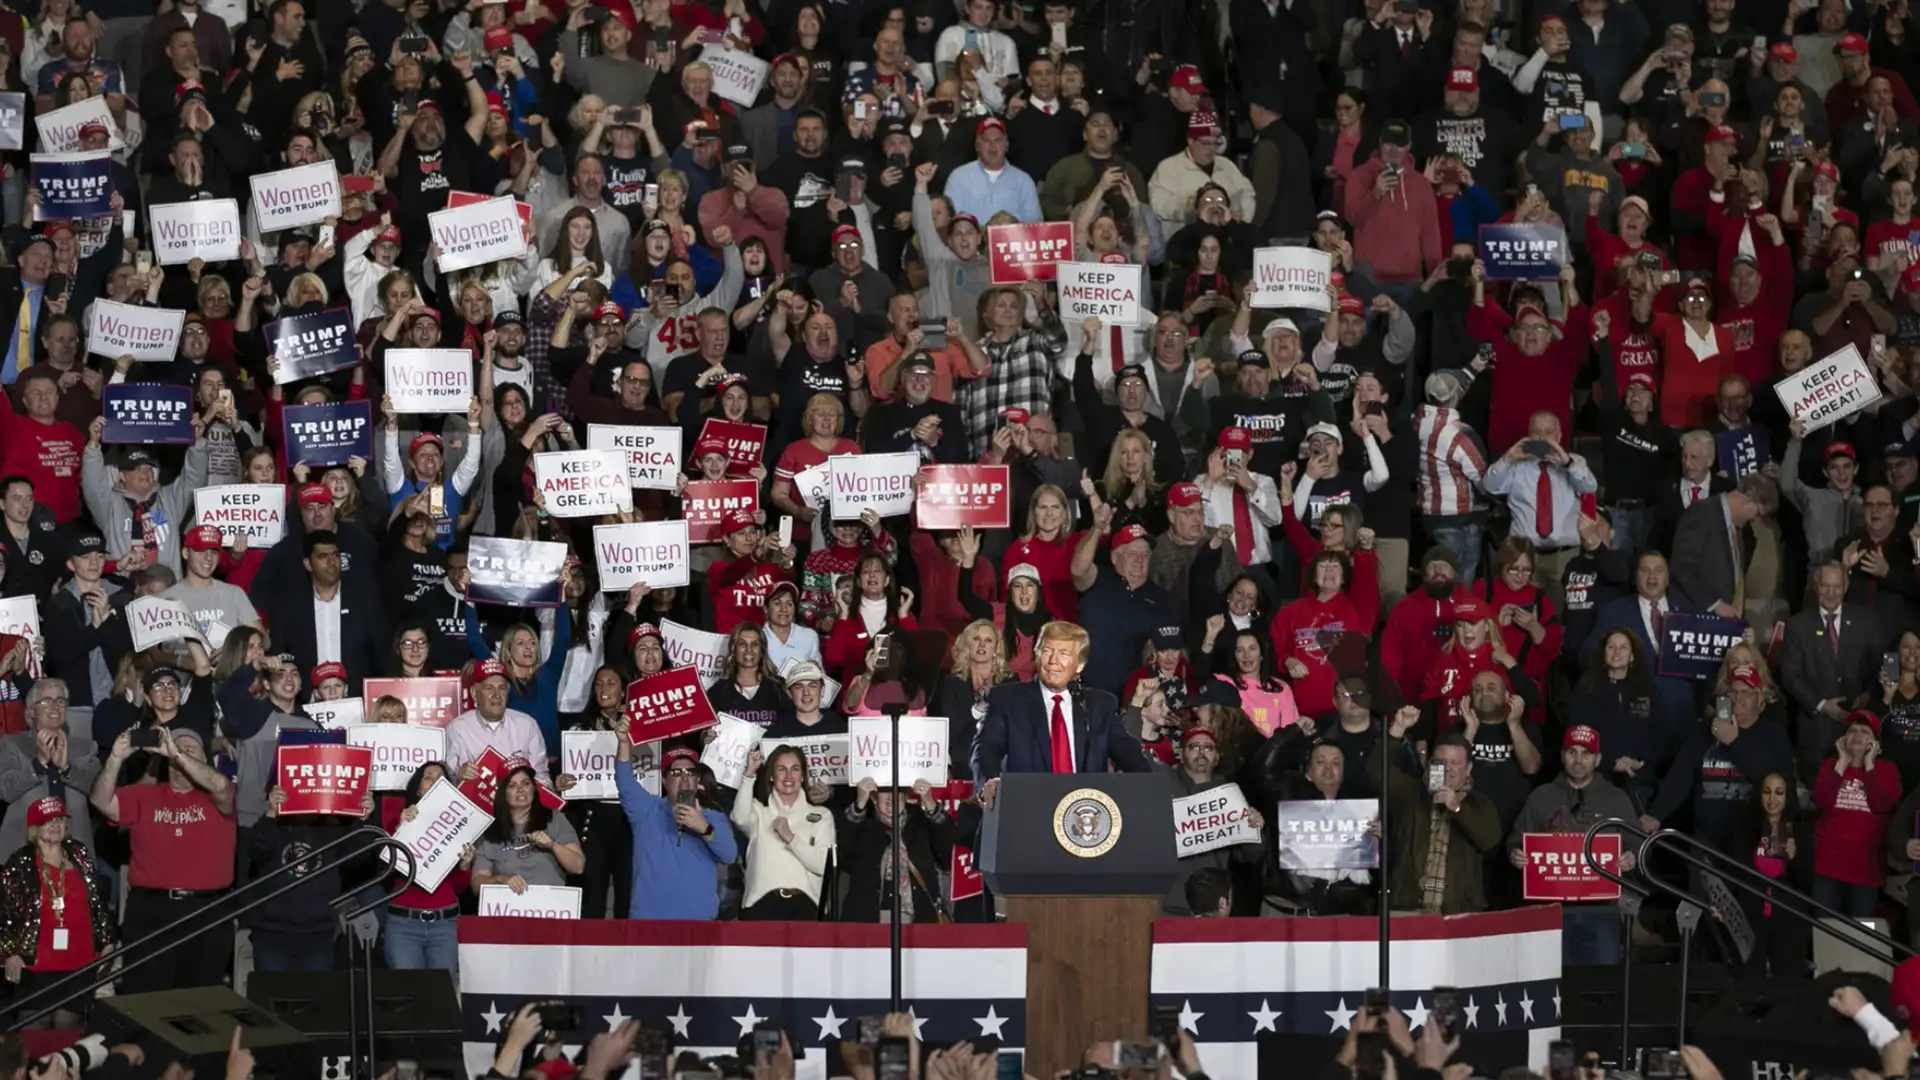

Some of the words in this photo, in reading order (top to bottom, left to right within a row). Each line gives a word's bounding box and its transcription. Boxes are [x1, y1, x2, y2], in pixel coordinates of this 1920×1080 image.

[711, 64, 757, 93] Wome
[40, 177, 107, 190] TRUMP
[47, 188, 103, 198] PENCE
[259, 181, 333, 208] Women
[614, 191, 642, 206] 2020
[271, 204, 293, 216] FOR
[296, 199, 329, 212] TRUMP
[157, 218, 233, 240] Women
[438, 217, 514, 247] Women
[168, 240, 188, 249] FOR
[191, 237, 226, 247] TRUMP
[451, 243, 471, 254] FOR
[475, 235, 509, 247] TRUMP
[997, 238, 1068, 253] TRUMP
[1485, 241, 1557, 252] TRUMP
[1004, 250, 1062, 262] PENCE
[1078, 272, 1115, 283] KEEP
[1260, 263, 1325, 285] Women
[1063, 286, 1134, 300] AMERICA
[1288, 284, 1321, 293] TRUMP
[1072, 302, 1122, 315] GREAT!
[98, 314, 173, 342] Women
[657, 313, 700, 353] 45
[104, 336, 126, 347] FOR
[129, 339, 164, 350] TRUMP
[273, 325, 348, 348] TRUMP
[283, 337, 344, 356] PENCE
[1620, 351, 1658, 365] GREAT
[392, 368, 468, 386] Women
[1801, 364, 1838, 391] KEEP
[1793, 369, 1865, 417] AMERICA
[110, 400, 187, 412] TRUMP
[1810, 388, 1862, 421] GREAT!
[117, 411, 181, 421] PENCE
[1234, 413, 1285, 432] Trump
[291, 418, 366, 434] TRUMP
[299, 431, 361, 443] PENCE
[614, 435, 654, 447] KEEP
[728, 438, 760, 453] UMP
[1743, 434, 1758, 474] TRU
[561, 461, 601, 473] KEEP
[629, 468, 662, 479] EAT!
[544, 475, 624, 491] AMERICA
[836, 472, 912, 492] Women
[925, 483, 1003, 495] TRUMP
[221, 494, 261, 505] KEEP
[557, 493, 613, 506] GREAT!
[682, 497, 753, 510] TRUMP
[846, 494, 868, 502] FOR
[872, 493, 905, 501] TRUMP
[933, 495, 996, 504] PENCE
[202, 508, 279, 522] AMERICA
[685, 510, 731, 519] PEN
[218, 525, 268, 537] GREAT!
[602, 543, 681, 564] Women
[612, 565, 634, 573] FOR
[636, 563, 674, 573] TRUMP
[733, 590, 765, 607] Tru
[138, 607, 195, 626] Wom
[437, 618, 466, 626] TRU
[149, 621, 172, 630] FOR
[1669, 631, 1742, 647] TRUMP
[663, 635, 724, 670] Wome
[1675, 644, 1722, 655] PENC
[630, 685, 697, 709] TRUMP
[635, 699, 695, 720] PENCE
[729, 710, 776, 721] omen
[802, 744, 830, 754] EEP
[865, 759, 889, 768] FOR
[285, 764, 366, 778] TRUMP
[579, 773, 603, 781] FOR
[808, 768, 845, 778] EAT!
[292, 778, 359, 788] PENCE
[1187, 797, 1228, 816] KEEP
[399, 798, 466, 865] Women
[1288, 819, 1371, 833] TRUMP
[422, 846, 441, 869] FOR
[442, 817, 469, 848] TRUMP
[1182, 825, 1242, 848] GREAT!
[1296, 832, 1362, 842] PENCE
[1530, 852, 1614, 865] TRUMP
[1538, 866, 1592, 874] PENC
